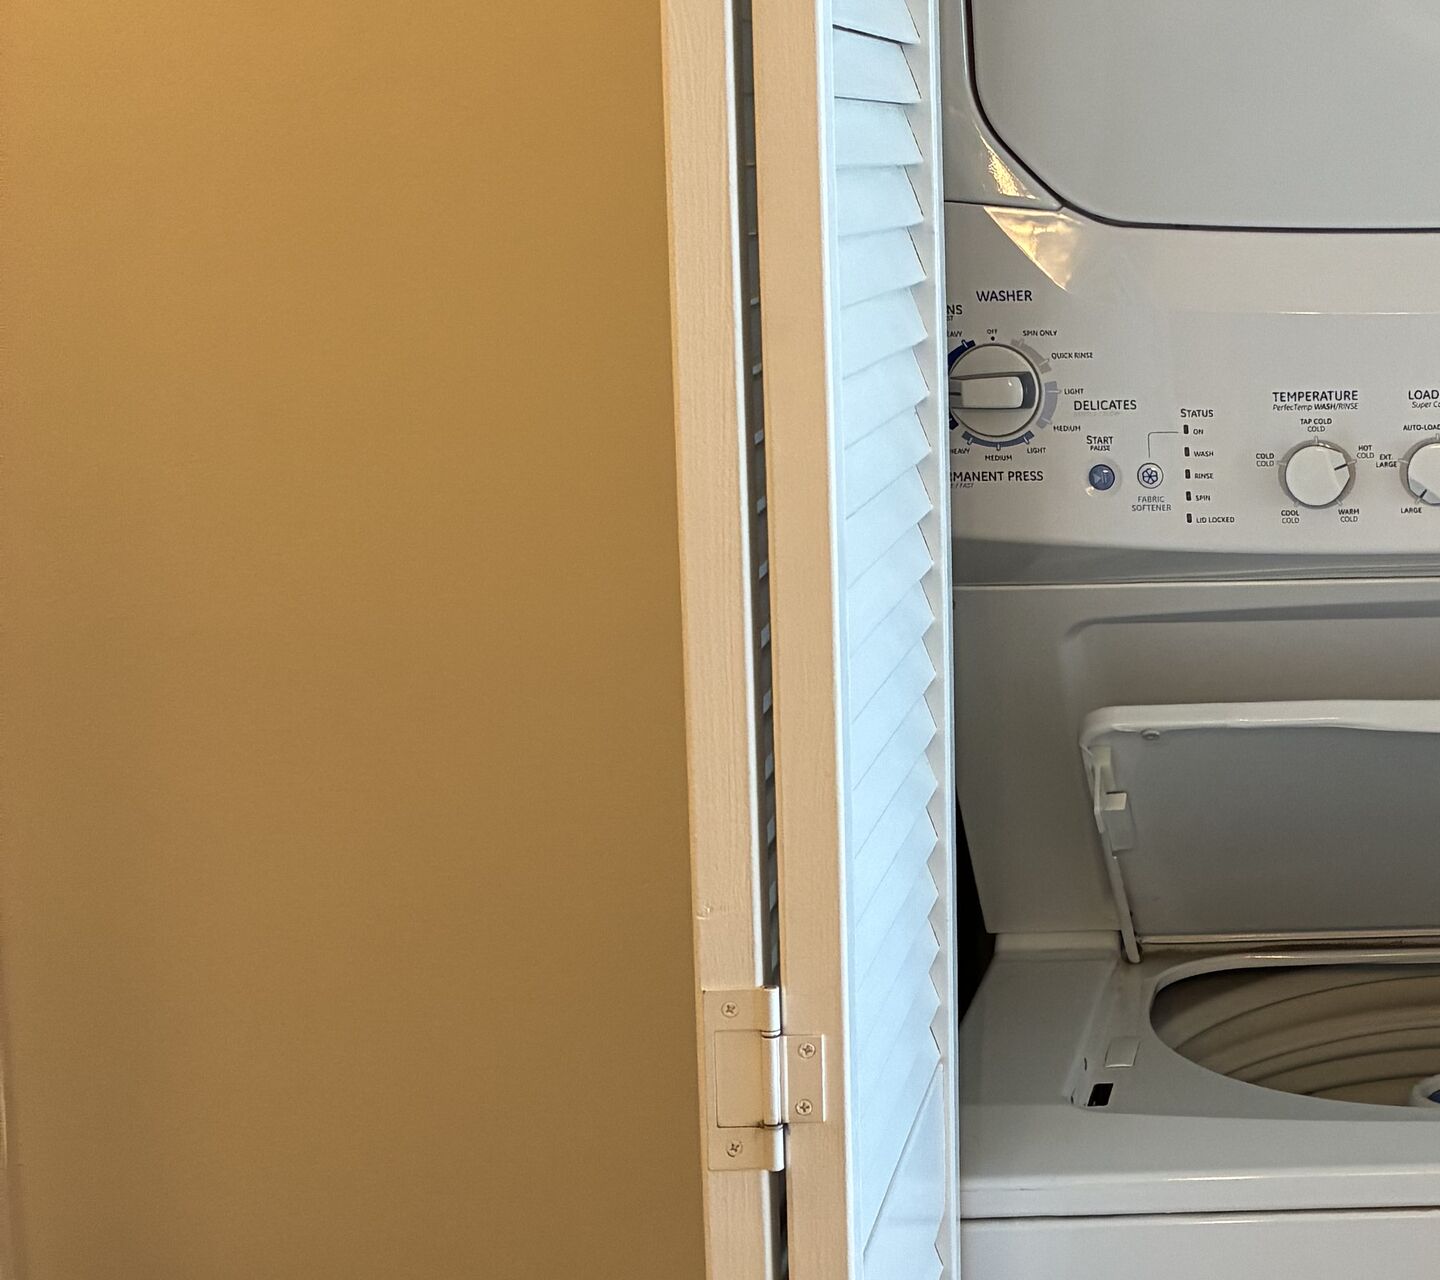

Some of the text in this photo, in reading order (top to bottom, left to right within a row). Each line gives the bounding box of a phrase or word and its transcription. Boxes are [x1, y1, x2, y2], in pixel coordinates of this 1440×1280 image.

[976, 290, 1033, 302] WASHER
[1272, 390, 1359, 402] TEMPERATURE
[1408, 389, 1440, 400] LOAD
[1074, 400, 1137, 410] DELICATES
[1314, 402, 1359, 410] WASH/RINSE
[1412, 401, 1431, 409] Super
[1180, 409, 1214, 418] STATUS
[1086, 435, 1113, 445] START
[1008, 471, 1044, 481] PRESS
